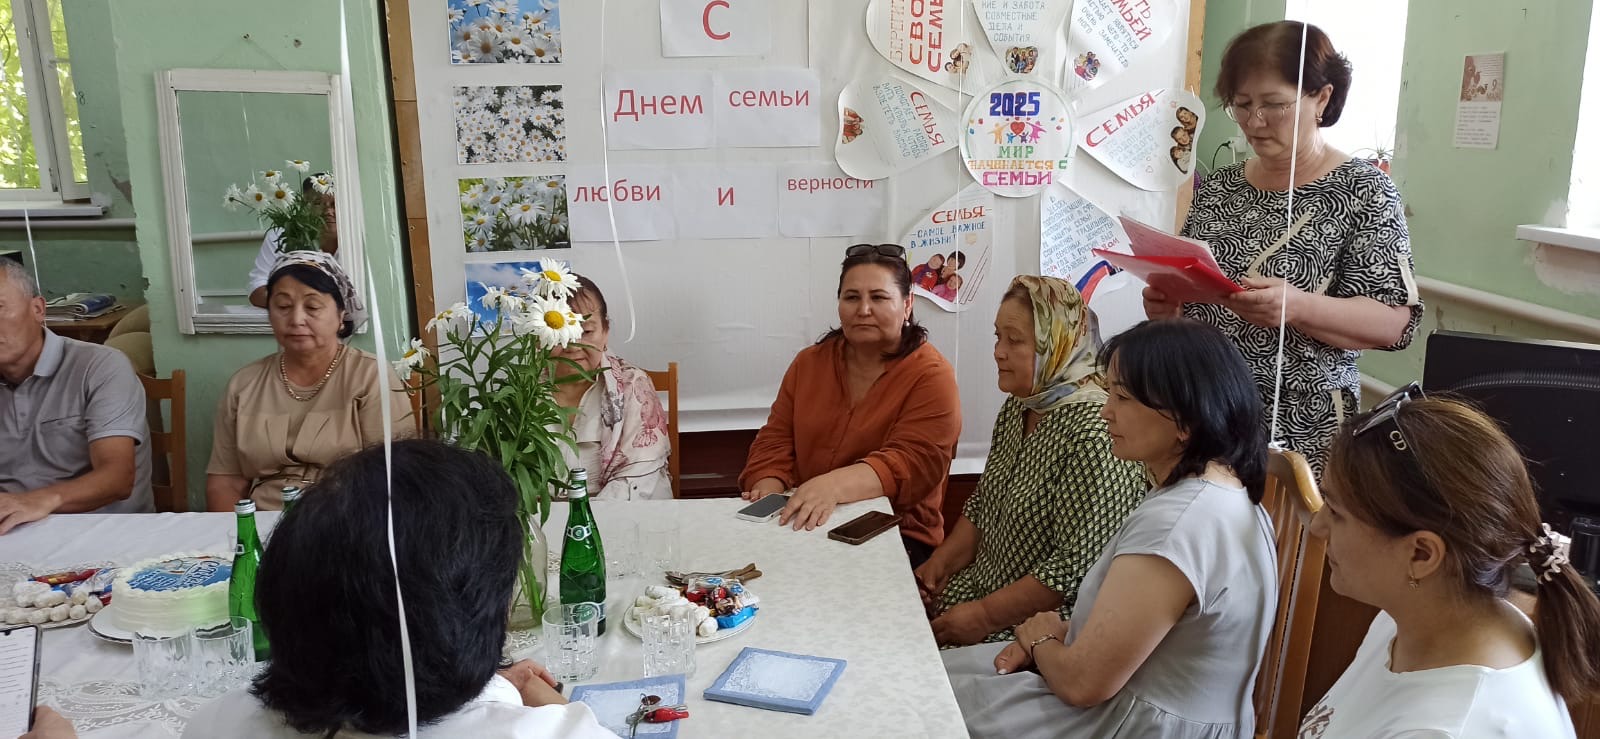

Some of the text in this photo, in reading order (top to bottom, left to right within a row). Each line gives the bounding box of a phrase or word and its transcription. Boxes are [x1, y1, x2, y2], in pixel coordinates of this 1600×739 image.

[1012, 1, 1045, 10] ЗАБОТА
[985, 12, 1038, 21] СОВМЕСТНЫЕ
[988, 22, 1023, 31] ДЕЛА И
[993, 33, 1031, 42] СОБЫТИЯ
[614, 88, 809, 122] Днем семьи
[989, 91, 1041, 117] 2025
[910, 91, 945, 146] СЕМЬЯ
[997, 145, 1034, 159] МИР
[968, 160, 1068, 170] НАЧИНАЕТСЯ С
[982, 171, 1052, 186] СЕМЬИ
[573, 177, 874, 206] любви и верности
[952, 222, 985, 233] ВАЖНОЕ
[1390, 430, 1407, 450] CD
